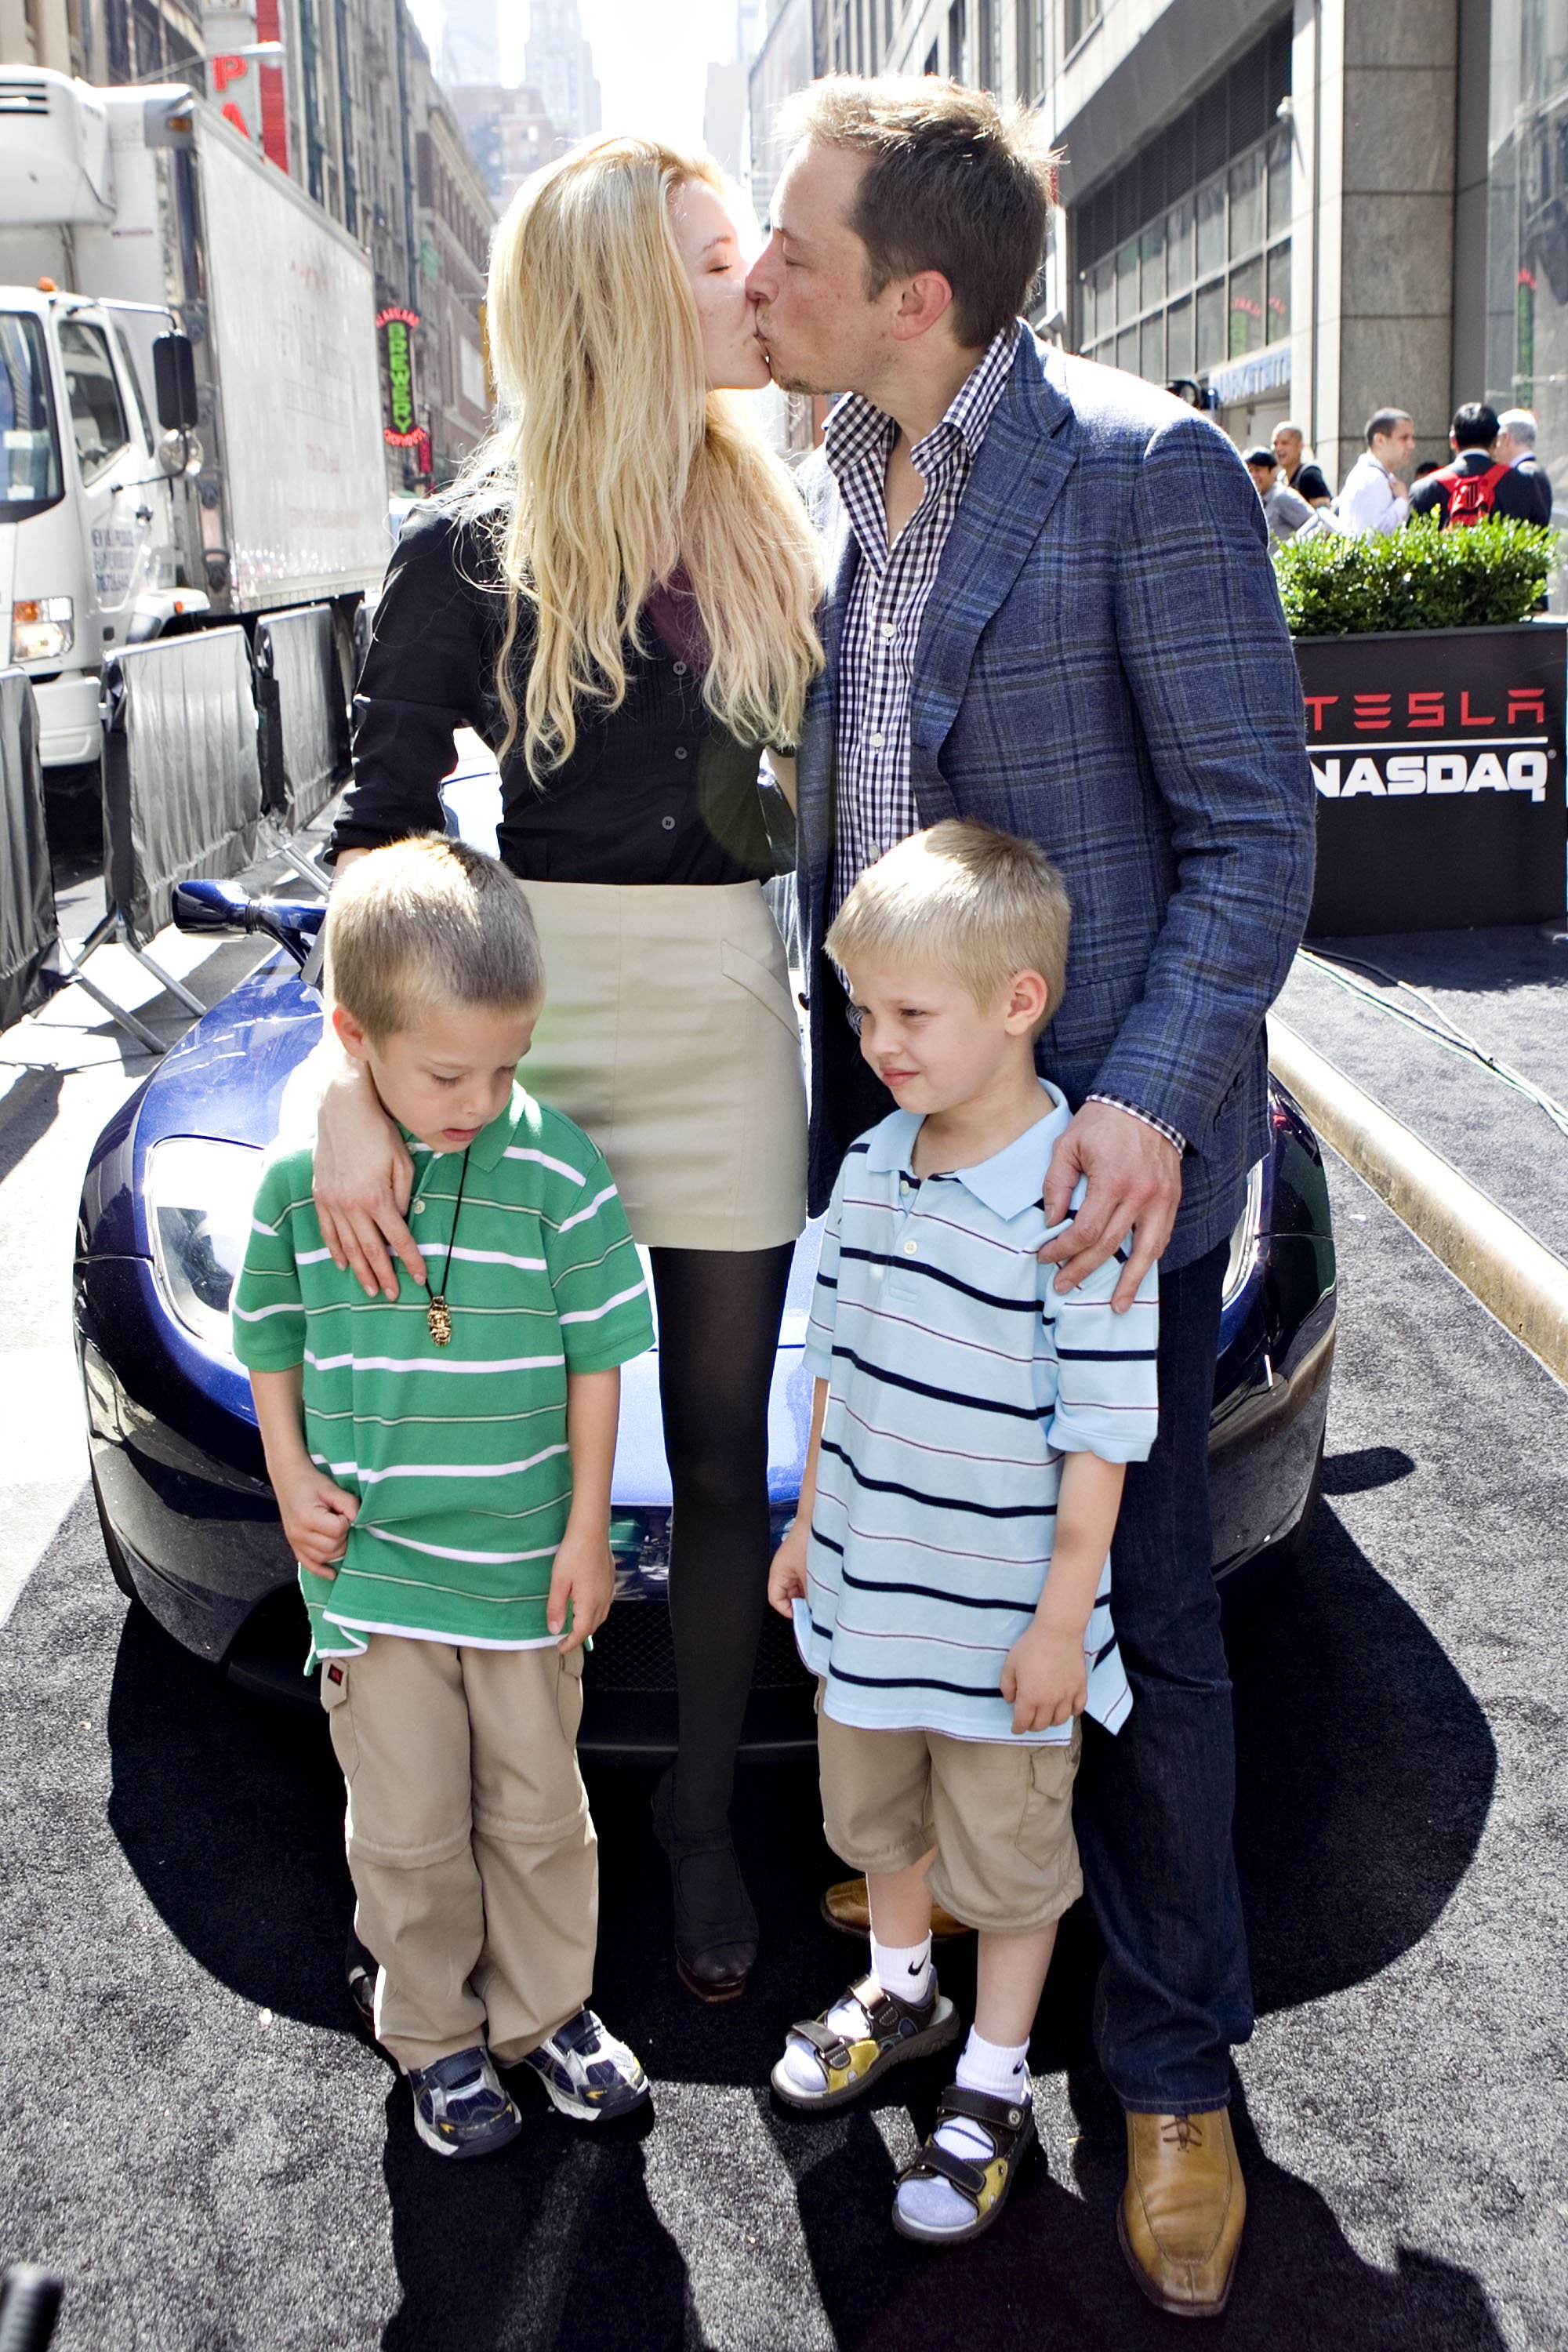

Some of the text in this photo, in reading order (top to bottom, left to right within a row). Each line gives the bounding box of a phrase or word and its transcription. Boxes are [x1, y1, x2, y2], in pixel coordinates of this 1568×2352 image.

[387, 321, 412, 434] BREWERY
[1304, 688, 1545, 731] TESLA
[1310, 750, 1548, 802] NASDAQ
